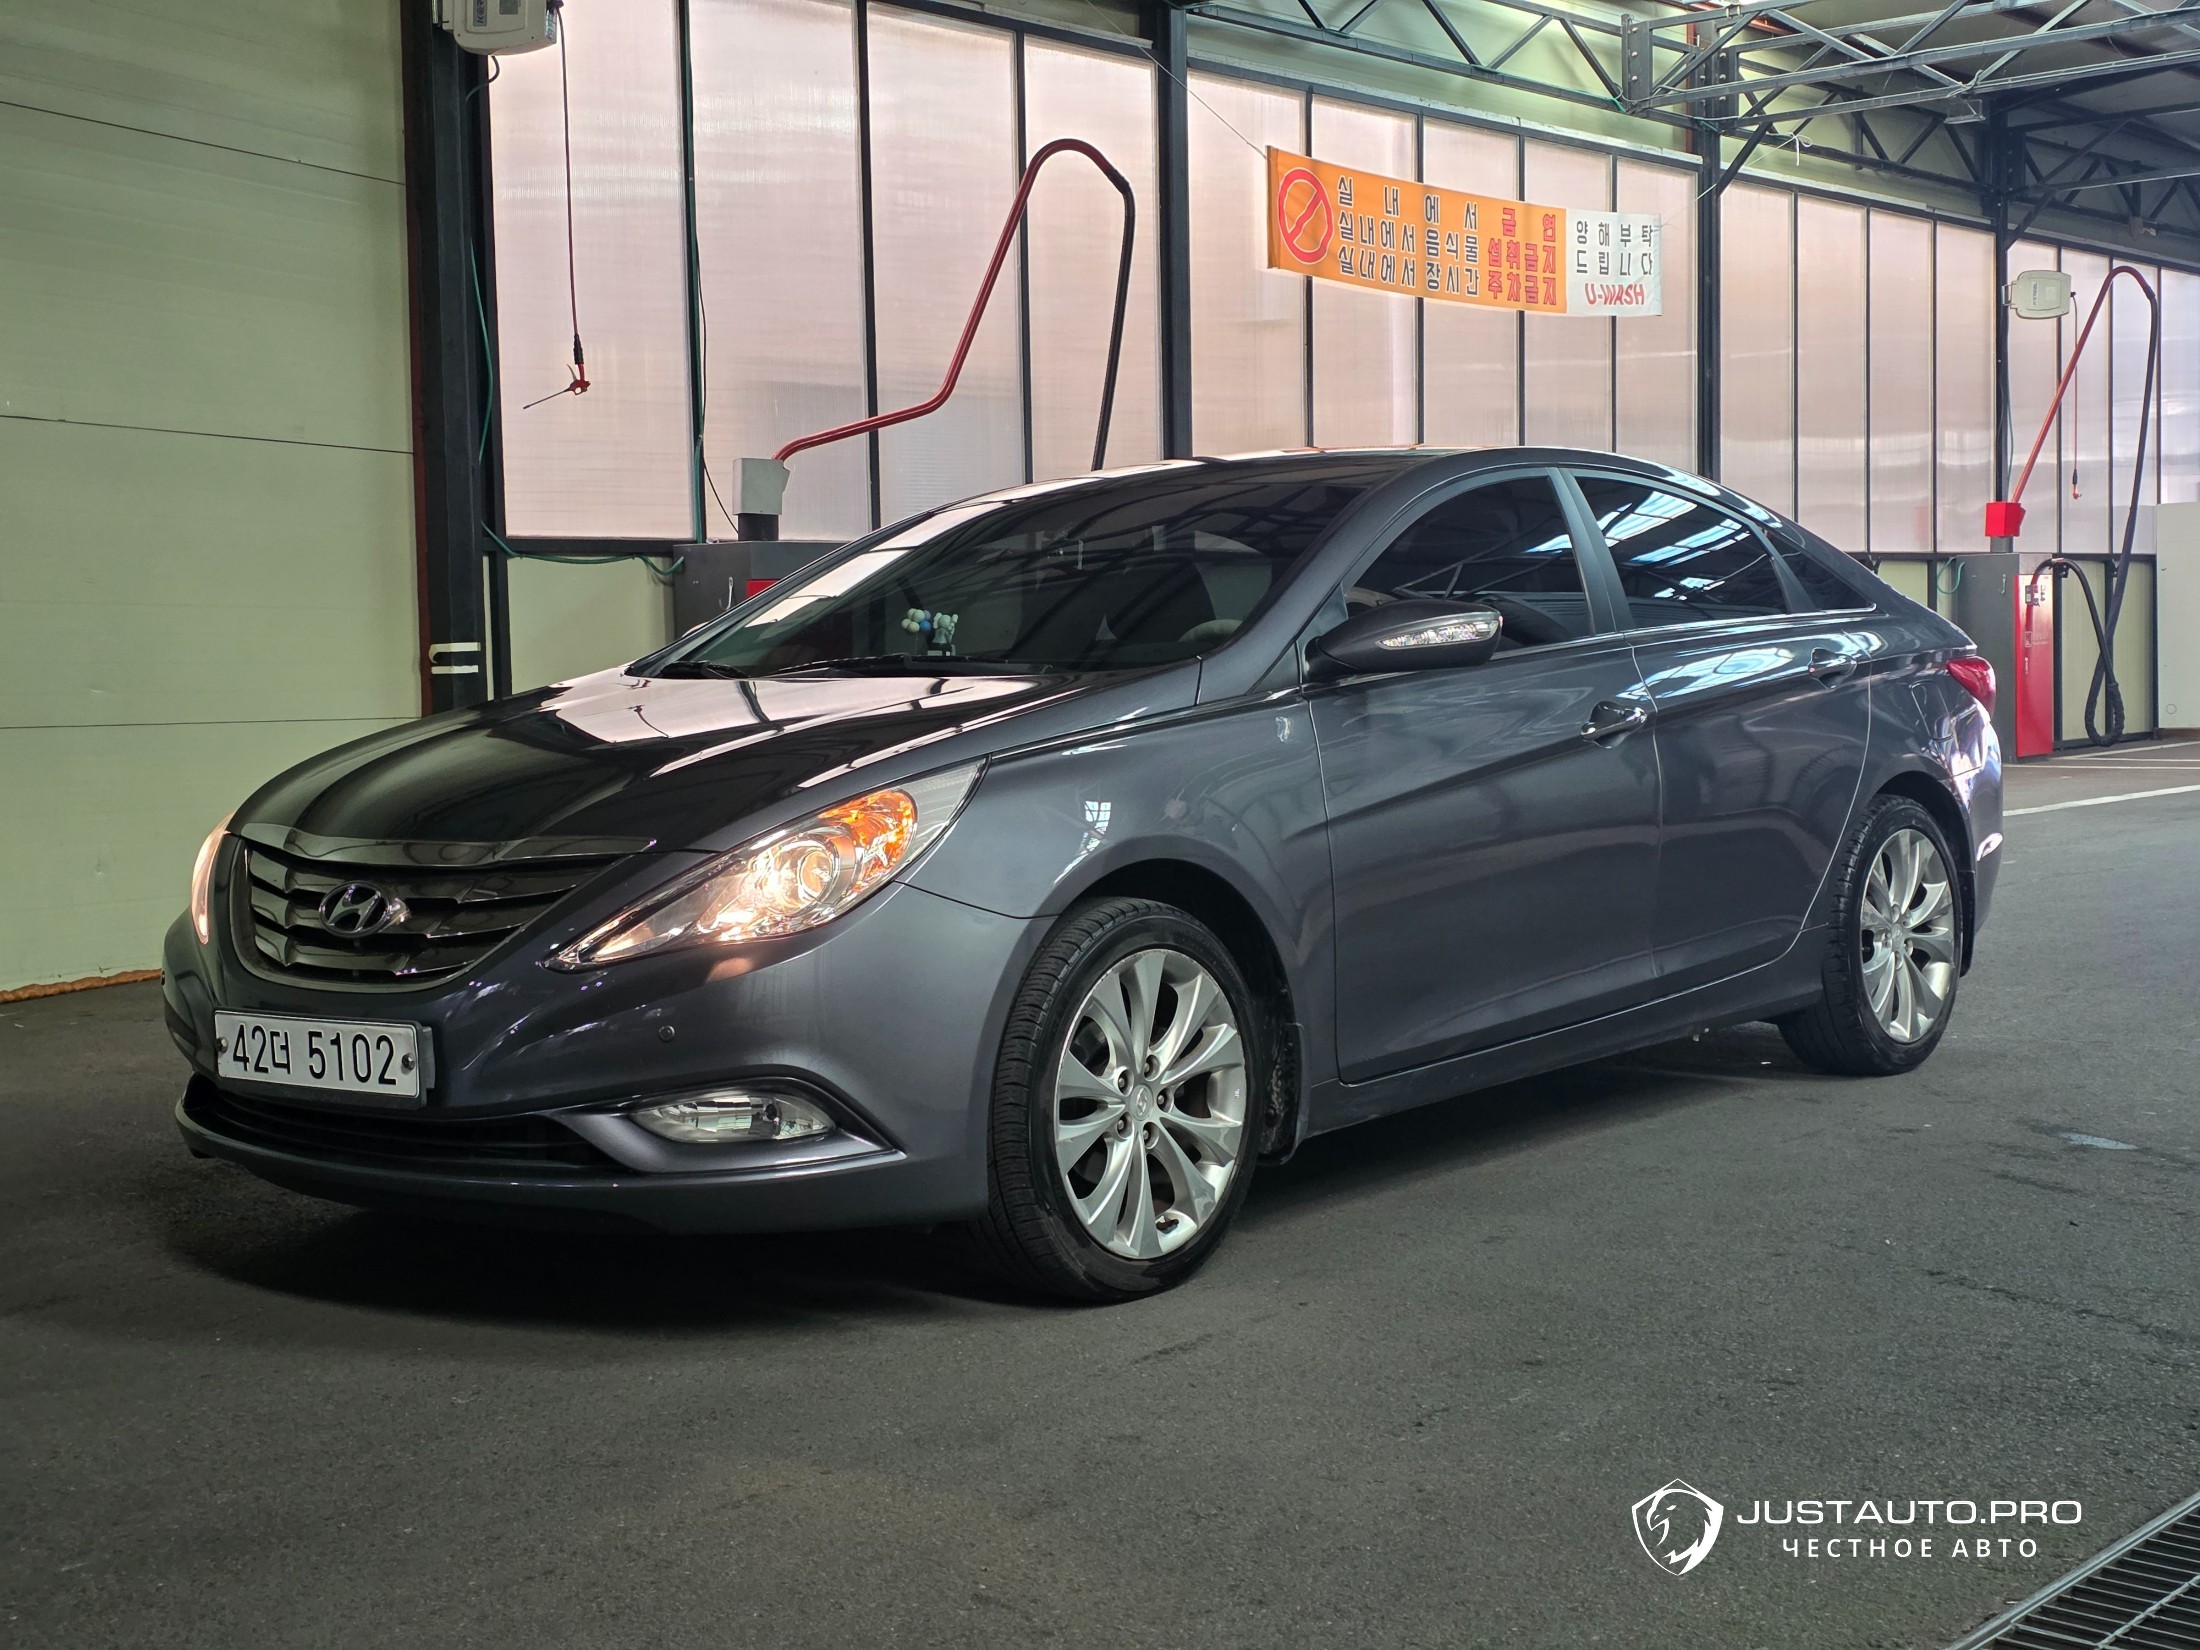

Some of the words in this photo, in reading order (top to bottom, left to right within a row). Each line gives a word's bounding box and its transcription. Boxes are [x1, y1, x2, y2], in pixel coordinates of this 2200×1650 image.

[1339, 211, 1415, 253] 실내에서
[1426, 229, 1478, 263] 음식물
[1338, 246, 1416, 287] 실내에서
[1426, 262, 1479, 296] 장시간
[1576, 250, 1653, 276] 드립니다
[1584, 283, 1646, 305] U-WASH
[233, 1024, 291, 1075] 42더
[308, 1031, 397, 1086] 5102
